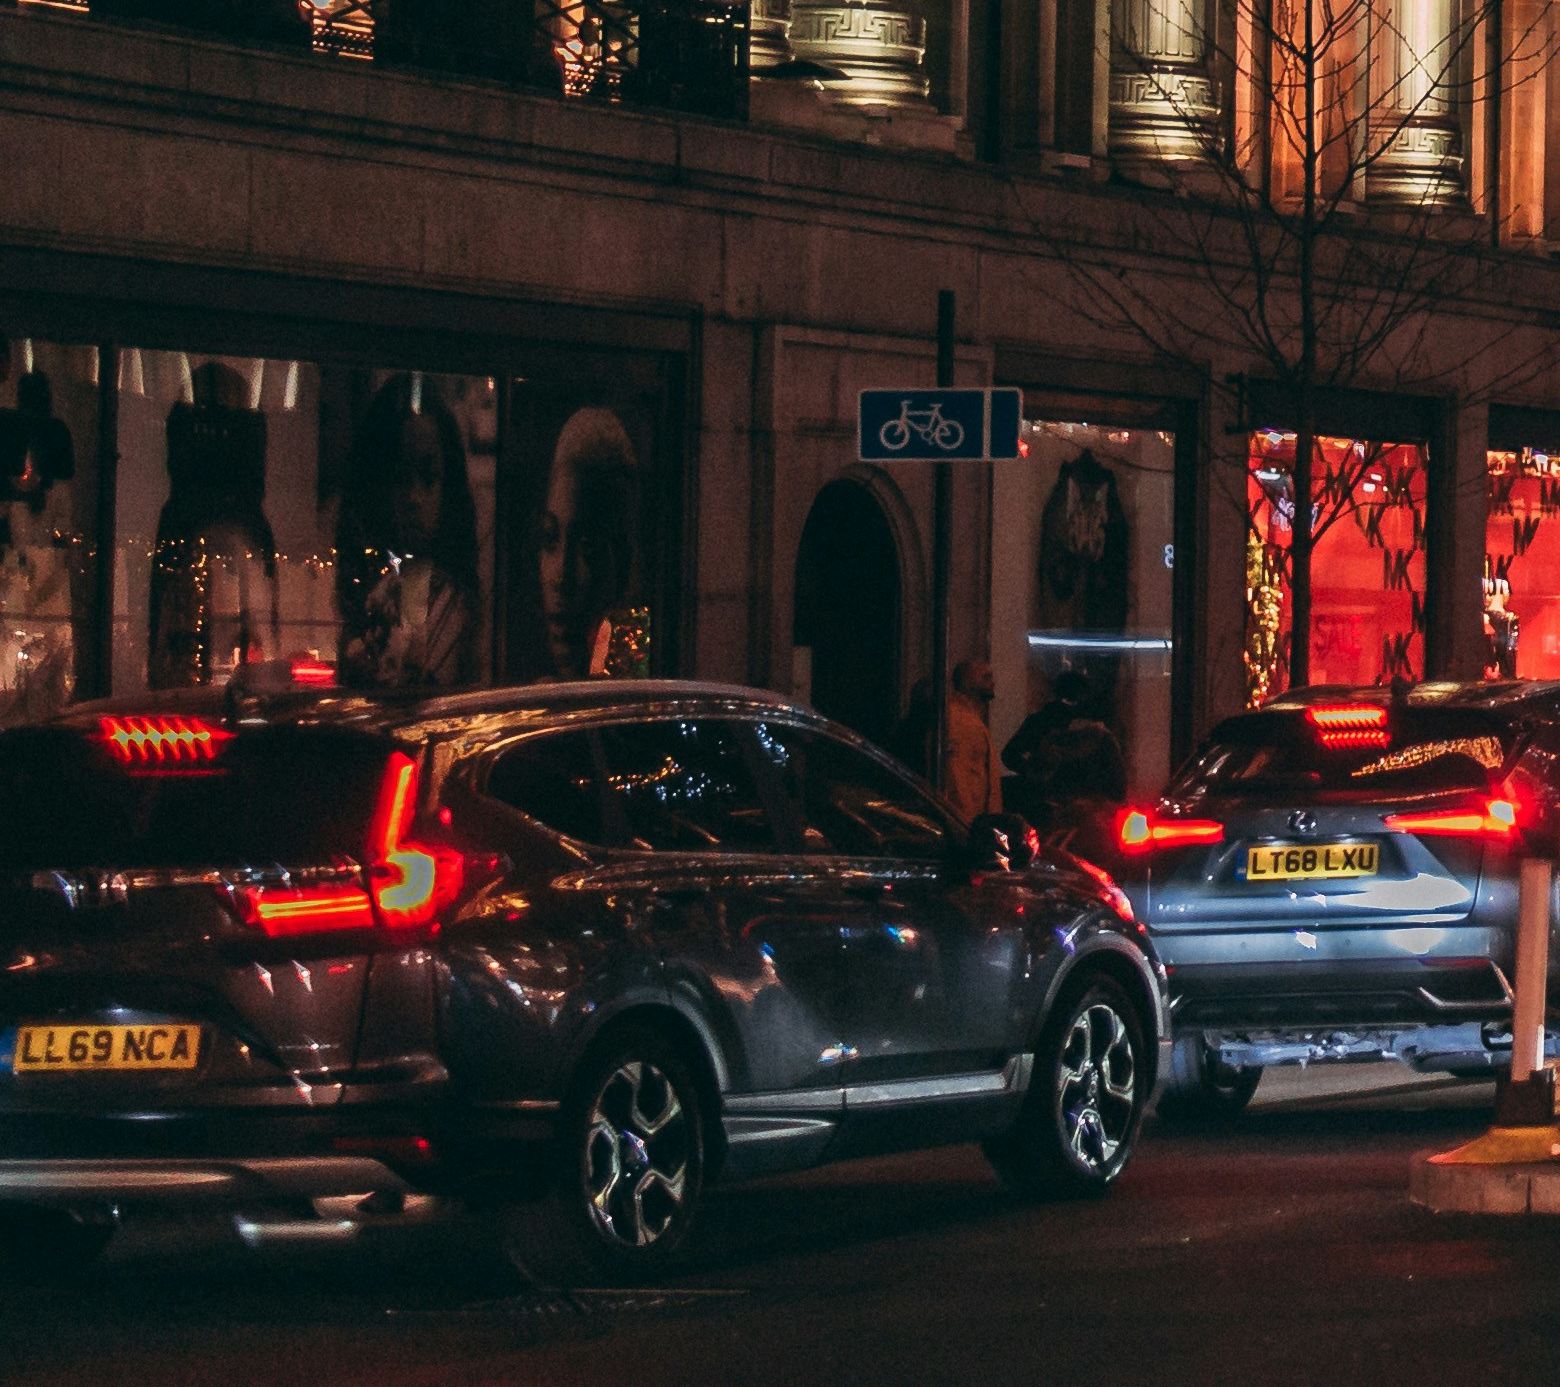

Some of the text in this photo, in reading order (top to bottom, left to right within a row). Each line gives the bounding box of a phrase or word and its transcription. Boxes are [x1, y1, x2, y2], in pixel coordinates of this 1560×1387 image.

[1384, 548, 1413, 591] MK
[1383, 631, 1414, 676] MK
[1252, 847, 1374, 875] LT68 LXU
[22, 1029, 189, 1063] LL69 NCA
